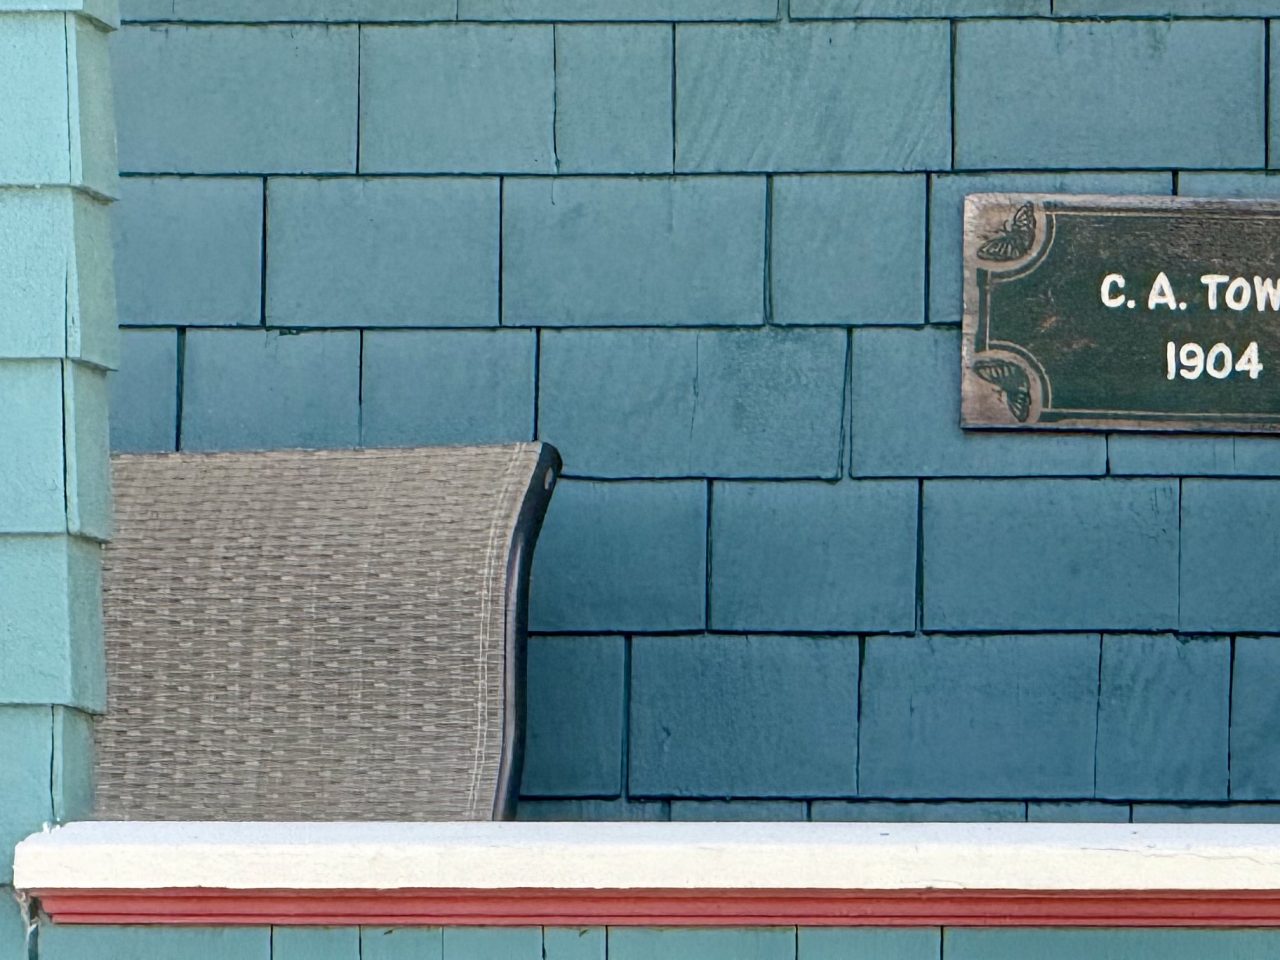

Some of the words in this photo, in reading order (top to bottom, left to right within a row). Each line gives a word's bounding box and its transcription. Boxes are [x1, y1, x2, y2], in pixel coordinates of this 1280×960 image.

[1099, 272, 1137, 310] C.
[1147, 271, 1188, 311] A.
[1165, 340, 1265, 381] 1904
